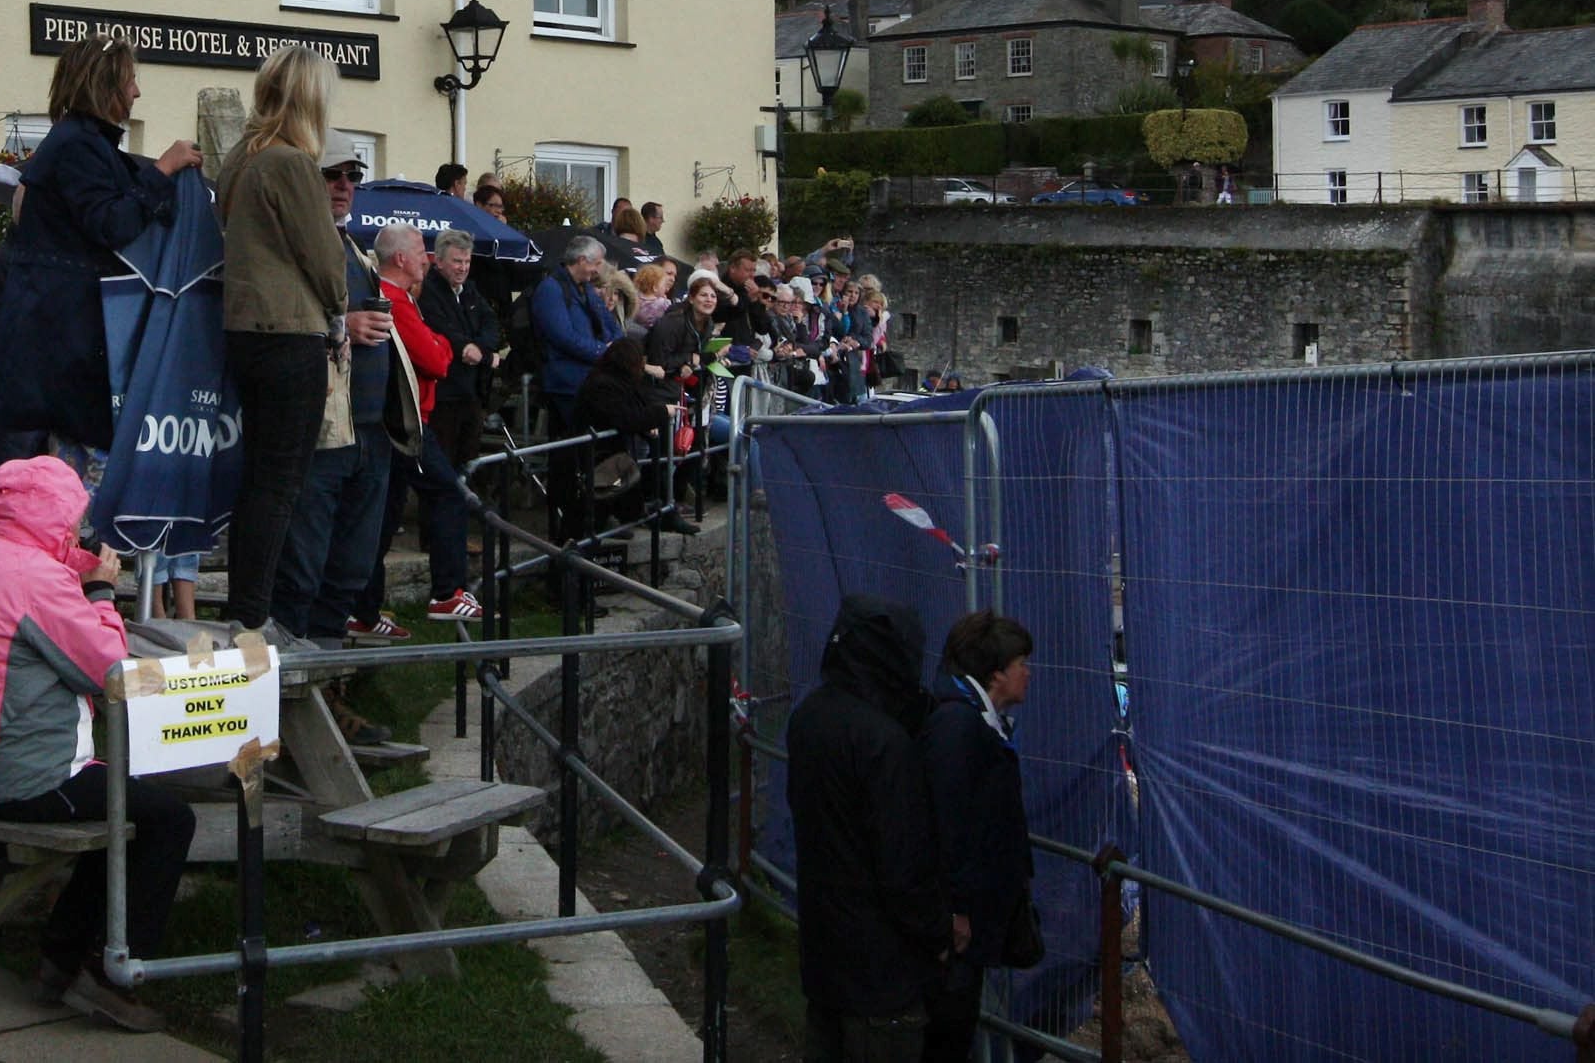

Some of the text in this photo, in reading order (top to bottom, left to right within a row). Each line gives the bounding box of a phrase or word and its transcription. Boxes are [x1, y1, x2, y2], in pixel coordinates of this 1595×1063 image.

[45, 17, 371, 66] PIER HOUSE HOTEL & REURANT
[361, 214, 450, 231] DOOM BAR
[168, 672, 250, 691] USTOMERS
[185, 698, 225, 714] ONLY
[162, 719, 248, 740] THANK YOU
